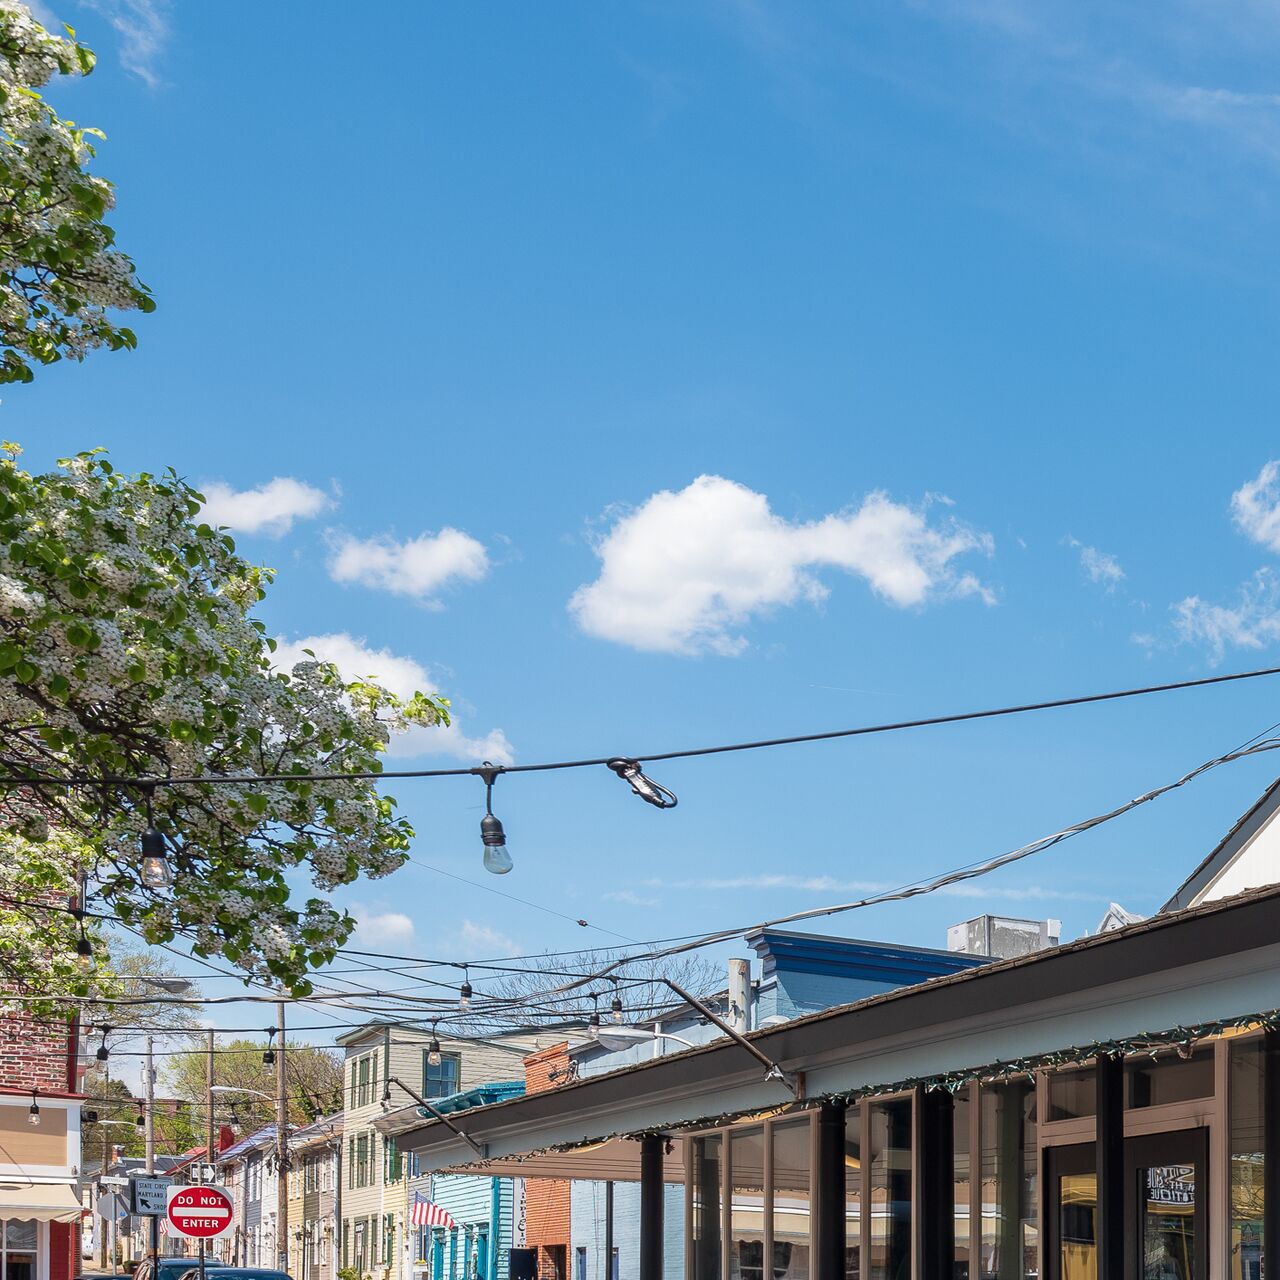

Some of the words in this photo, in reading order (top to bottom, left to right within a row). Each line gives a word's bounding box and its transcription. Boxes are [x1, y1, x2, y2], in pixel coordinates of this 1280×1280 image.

[138, 1191, 164, 1199] MARYLAND
[177, 1196, 194, 1205] DO
[200, 1196, 223, 1206] NOT
[182, 1219, 219, 1228] ENTER
